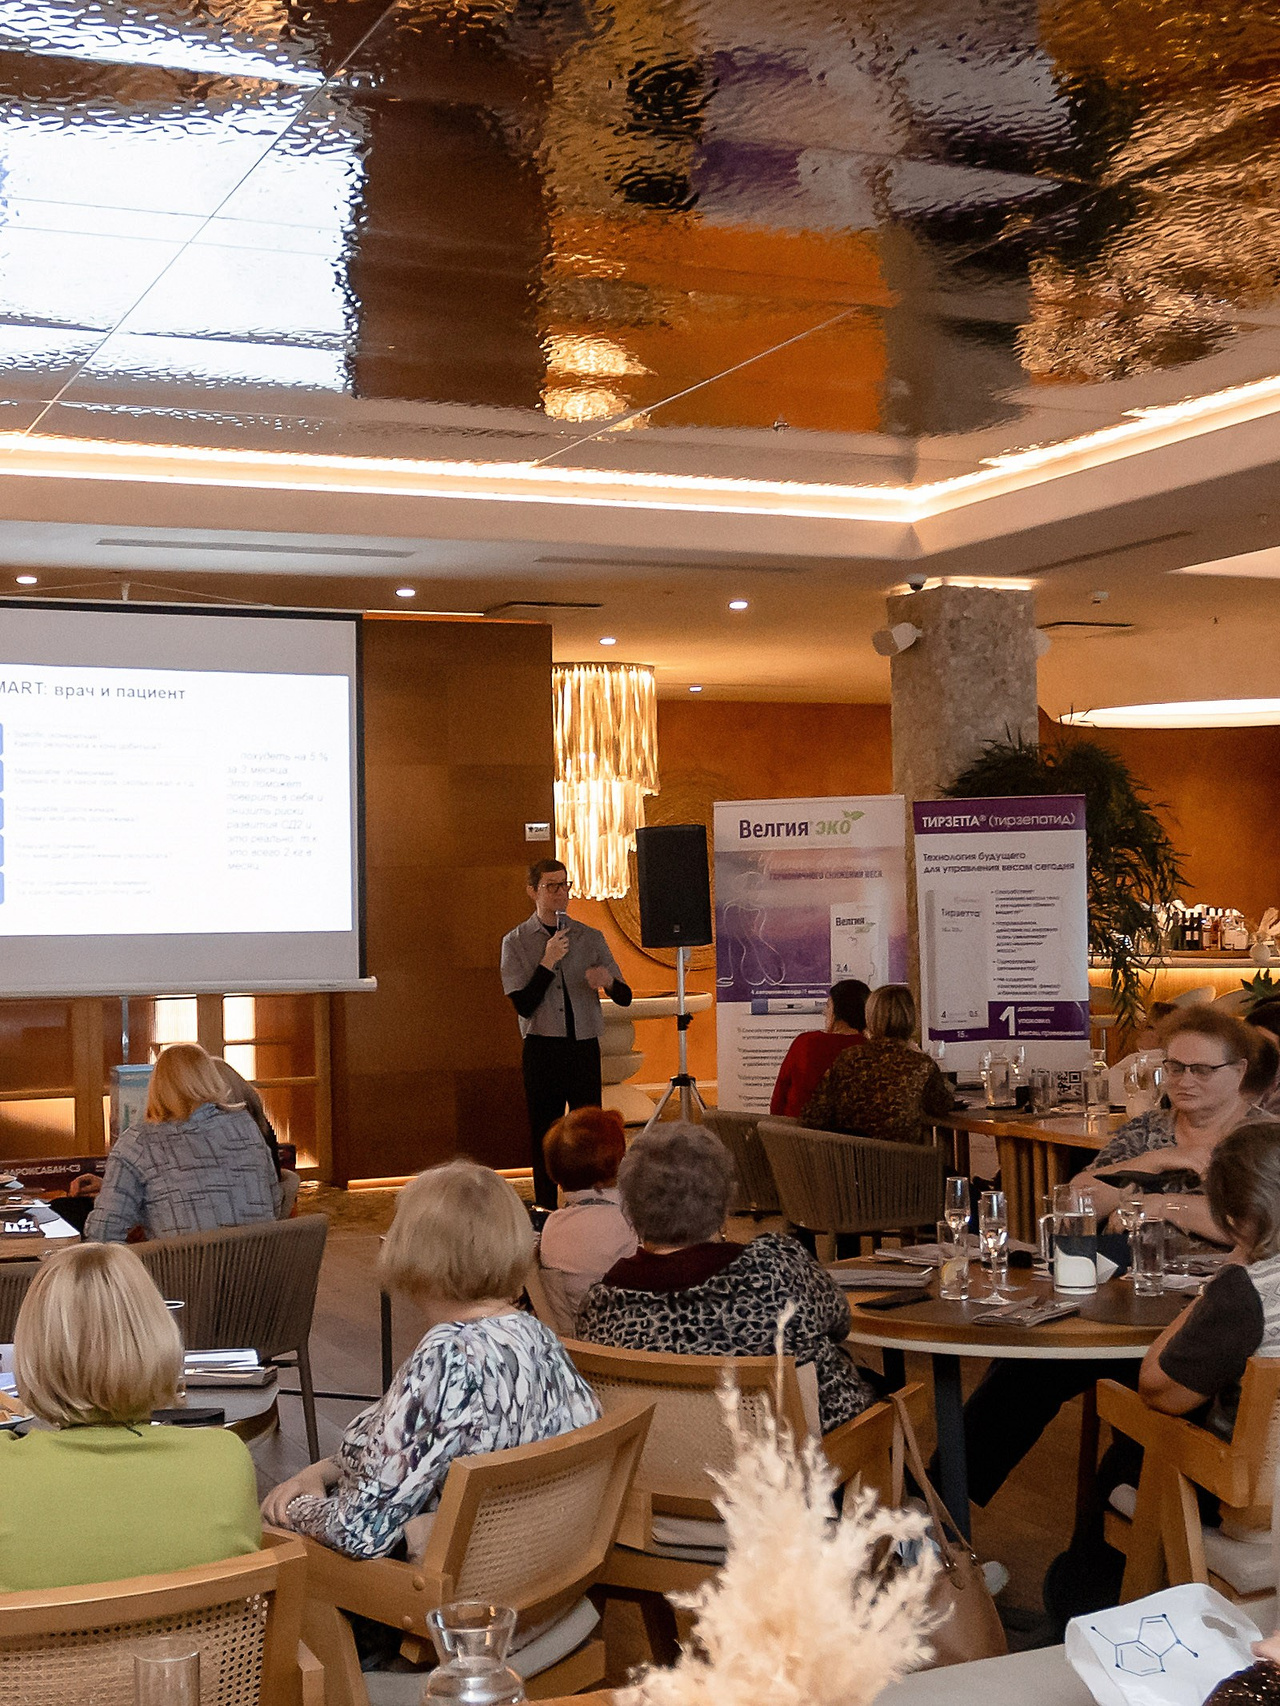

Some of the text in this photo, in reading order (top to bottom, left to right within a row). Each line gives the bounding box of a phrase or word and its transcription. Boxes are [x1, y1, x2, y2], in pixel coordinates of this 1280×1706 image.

[55, 685, 94, 699] врач
[101, 686, 110, 697] и
[117, 686, 185, 700] пациент
[310, 752, 316, 761] 5
[988, 812, 1076, 828] (тирзепатид)
[739, 820, 809, 839] Велгия
[923, 852, 1026, 862] Технология будущего
[943, 865, 1000, 874] управления
[1034, 863, 1074, 871] сегодня
[941, 908, 980, 918] Тирзетта
[836, 916, 865, 926] Велгия
[999, 1006, 1016, 1036] 1
